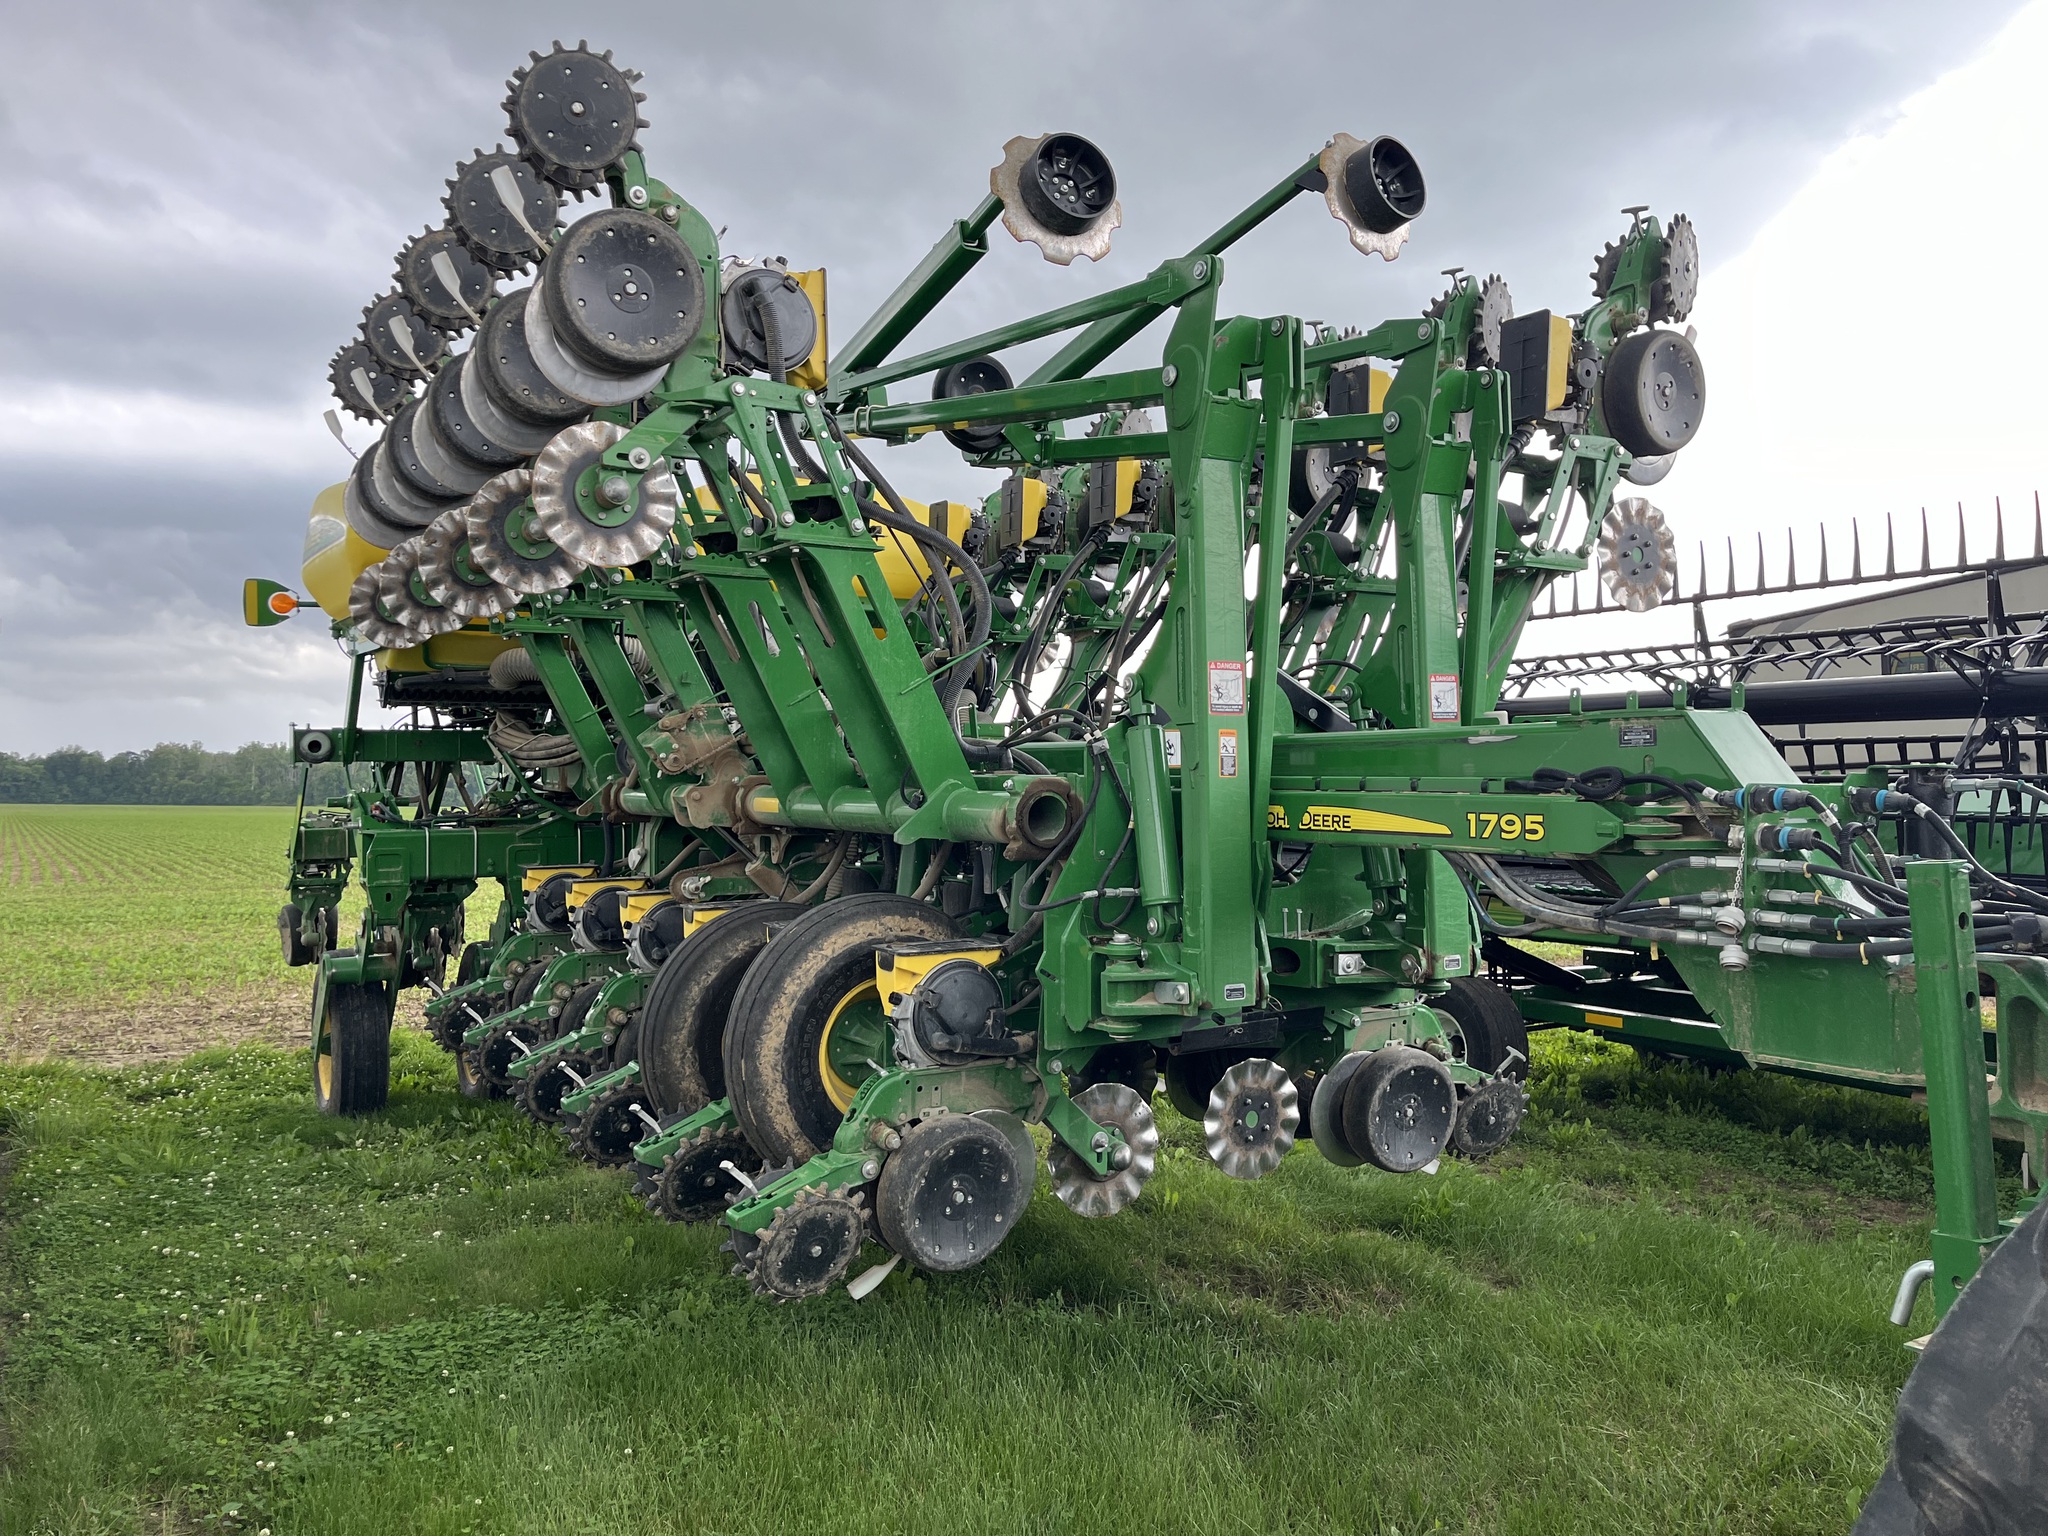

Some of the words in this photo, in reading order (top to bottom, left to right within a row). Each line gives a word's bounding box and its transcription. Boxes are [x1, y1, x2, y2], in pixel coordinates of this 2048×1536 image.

[1216, 662, 1241, 670] DANGER
[1300, 811, 1352, 829] DEERE
[1466, 812, 1546, 841] 1795
